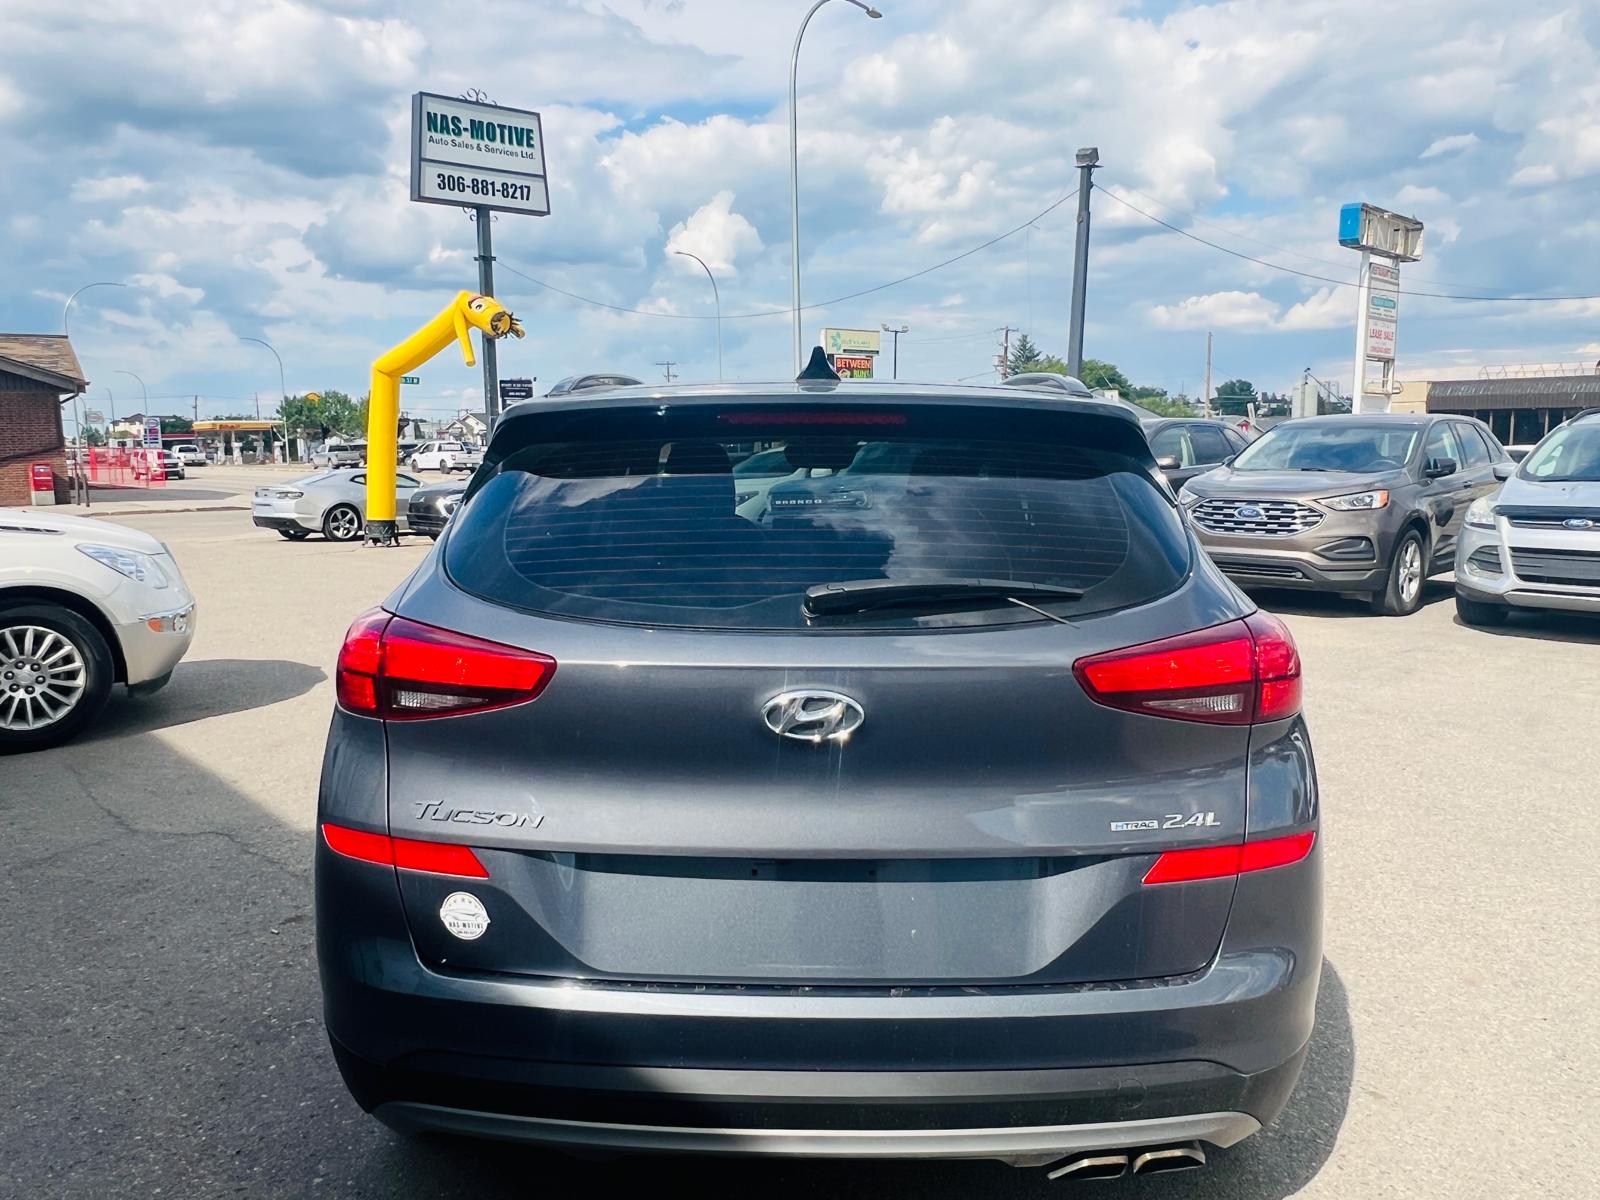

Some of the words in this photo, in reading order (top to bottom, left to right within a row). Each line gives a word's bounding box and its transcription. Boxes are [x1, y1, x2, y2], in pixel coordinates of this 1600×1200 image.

[426, 111, 535, 149] NAS-MOTIVE
[428, 135, 449, 147] Auto
[451, 139, 475, 151] Sales
[476, 143, 483, 152] &
[484, 144, 519, 158] Services
[520, 150, 536, 160] Ltd.
[437, 173, 531, 201] 306-881-8217
[836, 358, 871, 369] BETWEEN
[1113, 820, 1157, 830] HTRAC
